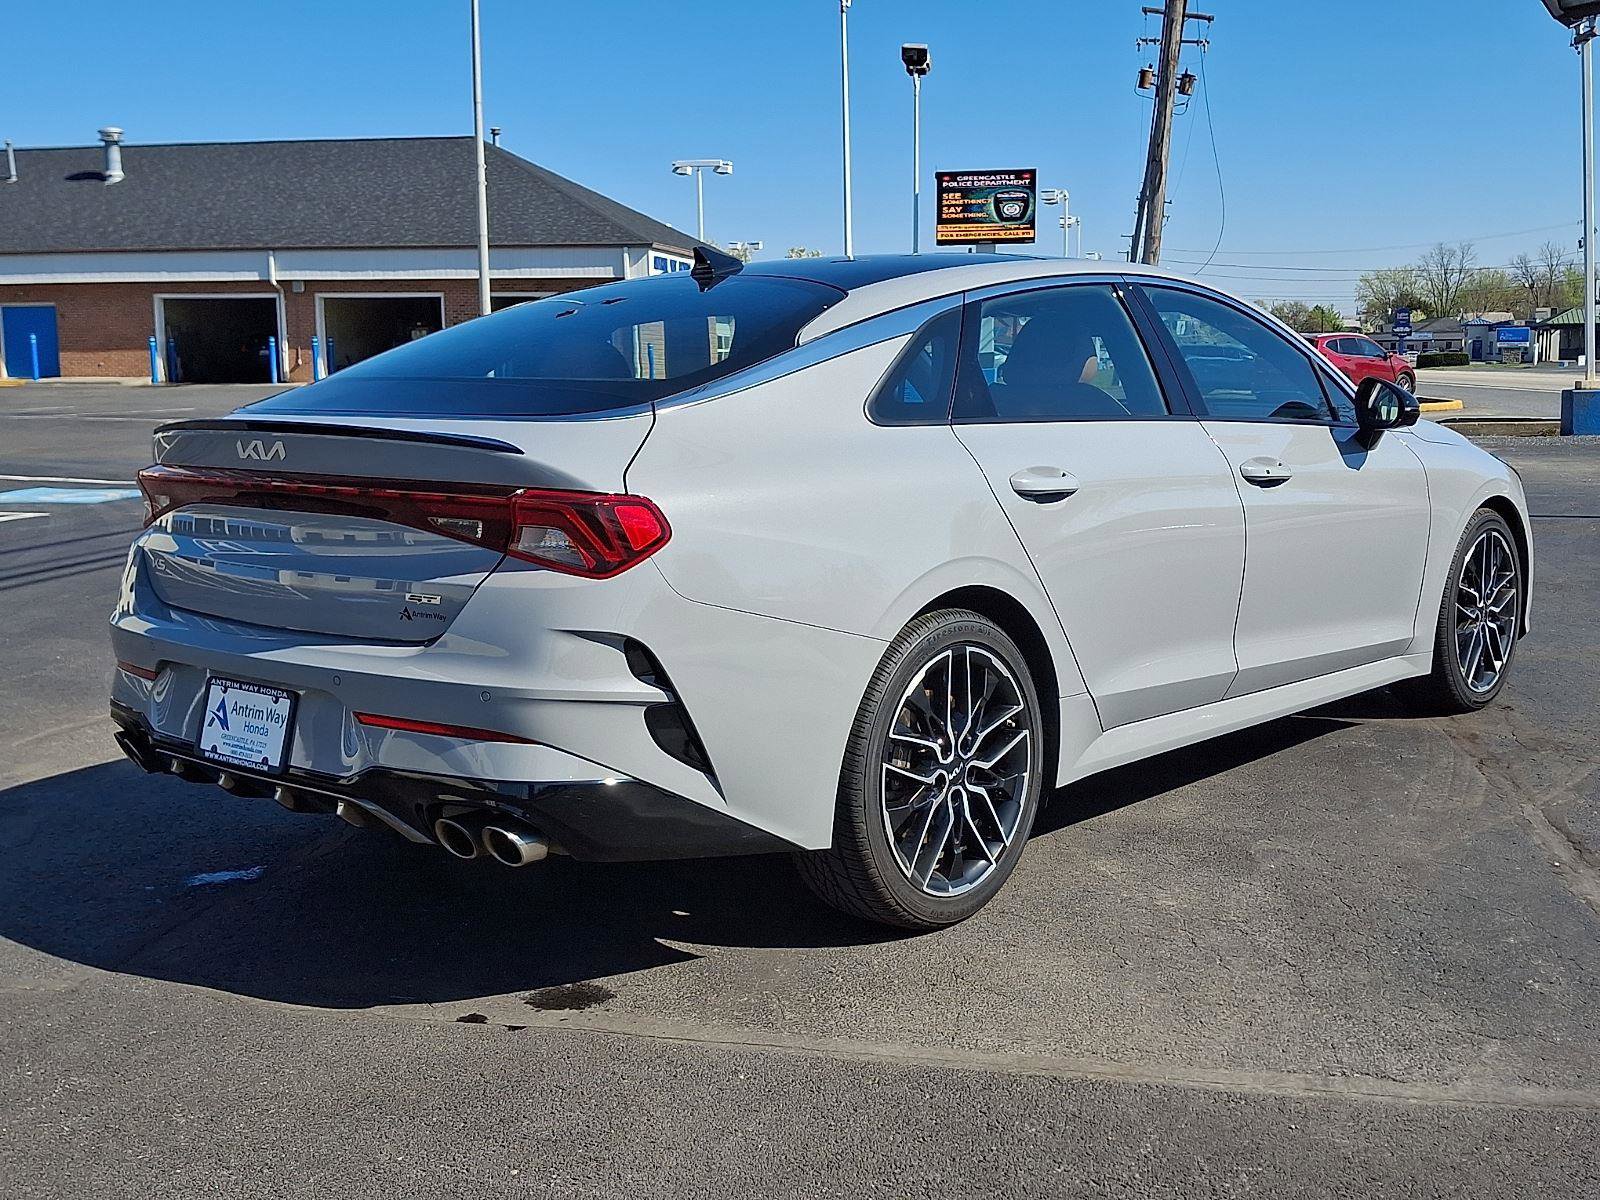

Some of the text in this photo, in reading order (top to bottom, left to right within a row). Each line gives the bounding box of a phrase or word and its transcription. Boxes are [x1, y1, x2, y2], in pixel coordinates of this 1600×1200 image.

[973, 179, 1031, 187] DEPARTMENT
[236, 439, 286, 461] KIA
[412, 610, 447, 622] Antrim Way
[210, 678, 288, 698] ANTRIM WAY HONDA
[230, 700, 287, 728] Antrim Way
[243, 720, 269, 737] Honda
